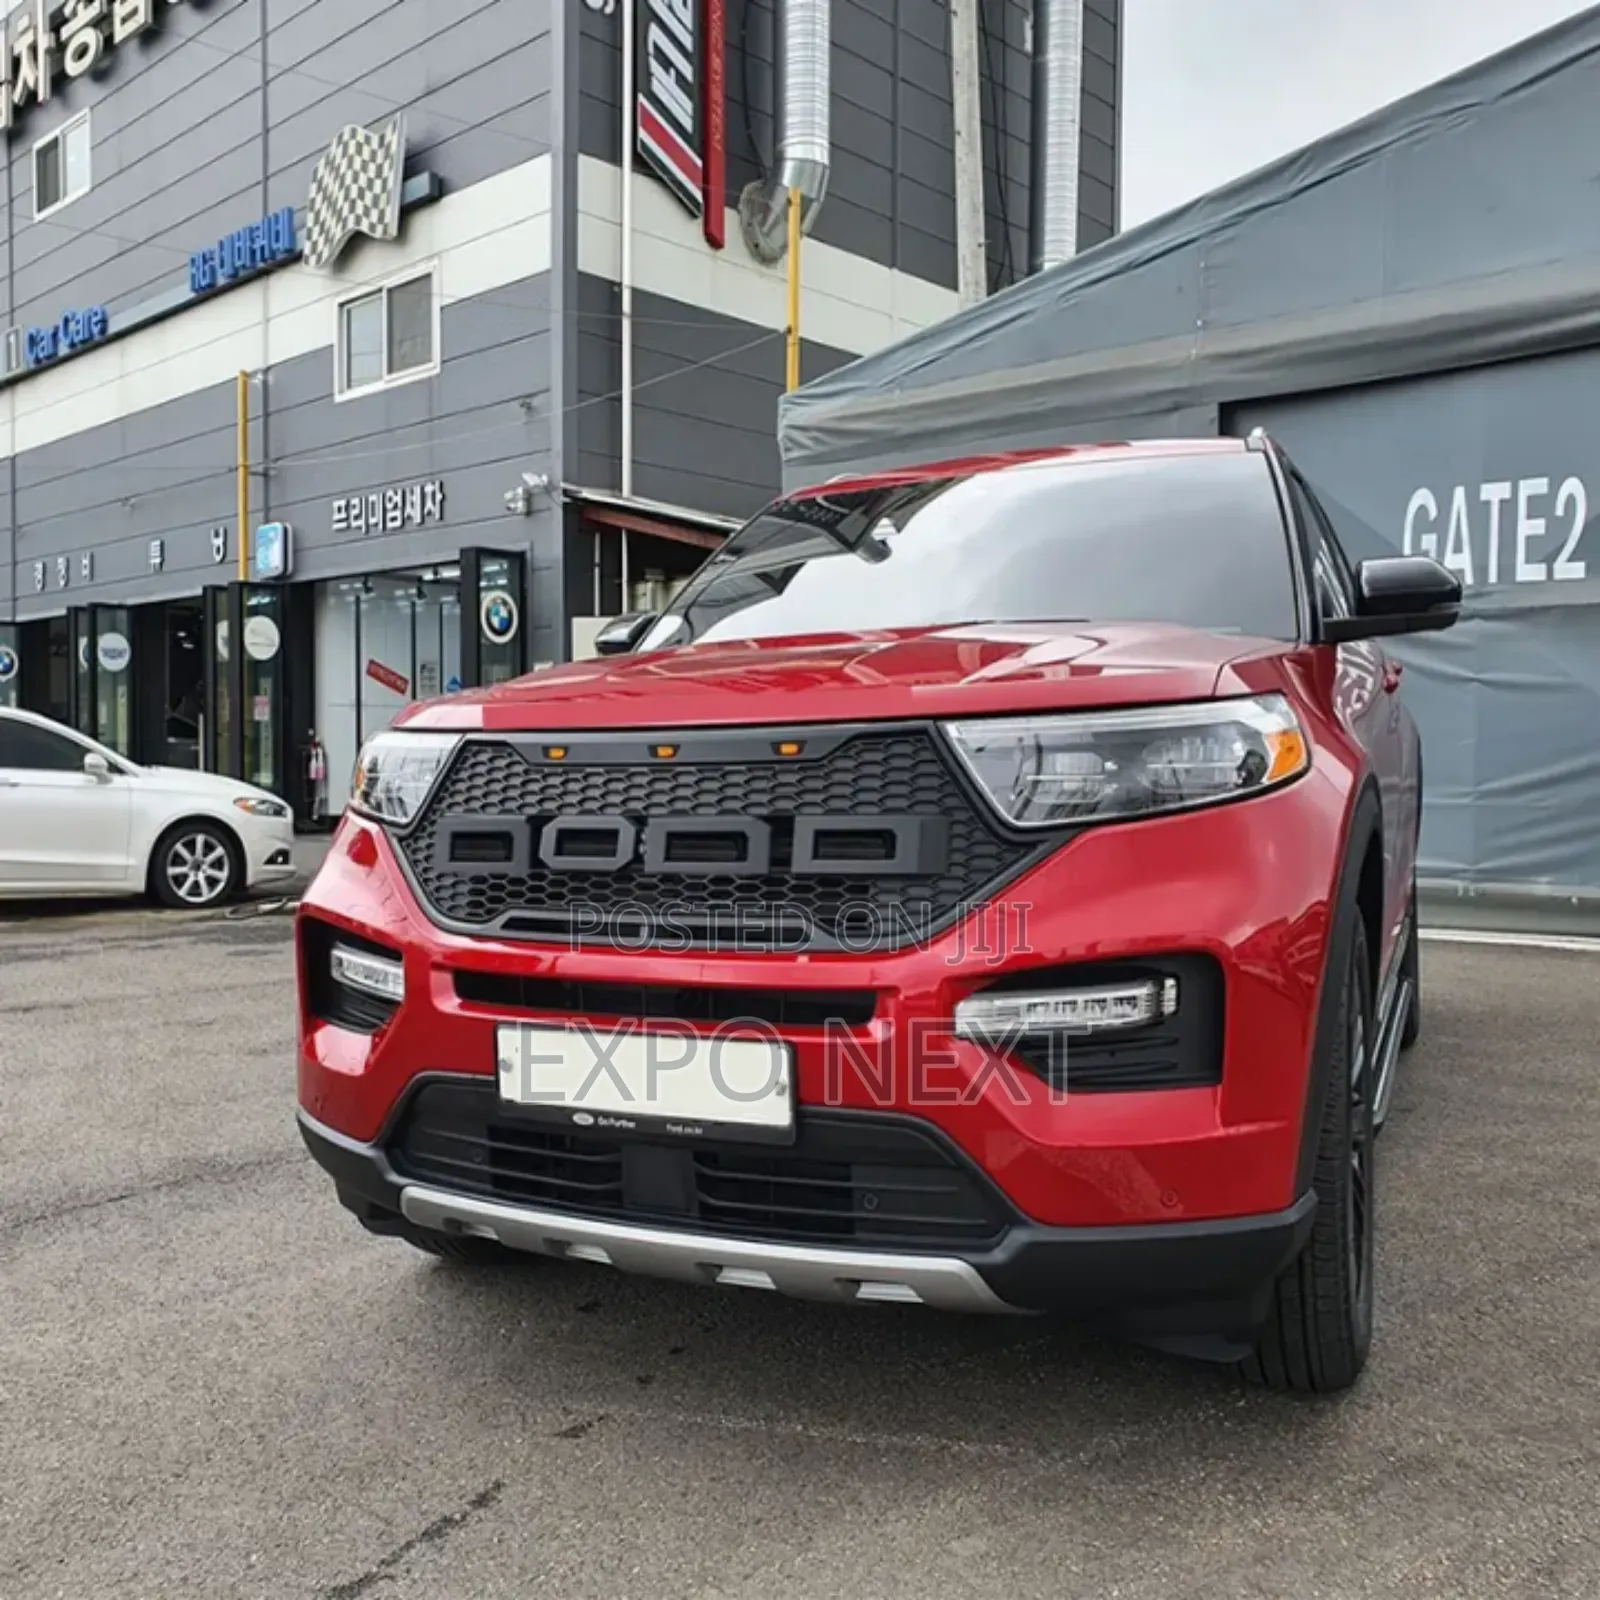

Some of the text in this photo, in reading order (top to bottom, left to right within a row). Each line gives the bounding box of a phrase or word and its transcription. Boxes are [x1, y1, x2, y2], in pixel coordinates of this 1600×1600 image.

[25, 304, 108, 364] Car Care
[331, 479, 444, 534] 프리미엄세차
[1403, 475, 1587, 585] GATE2
